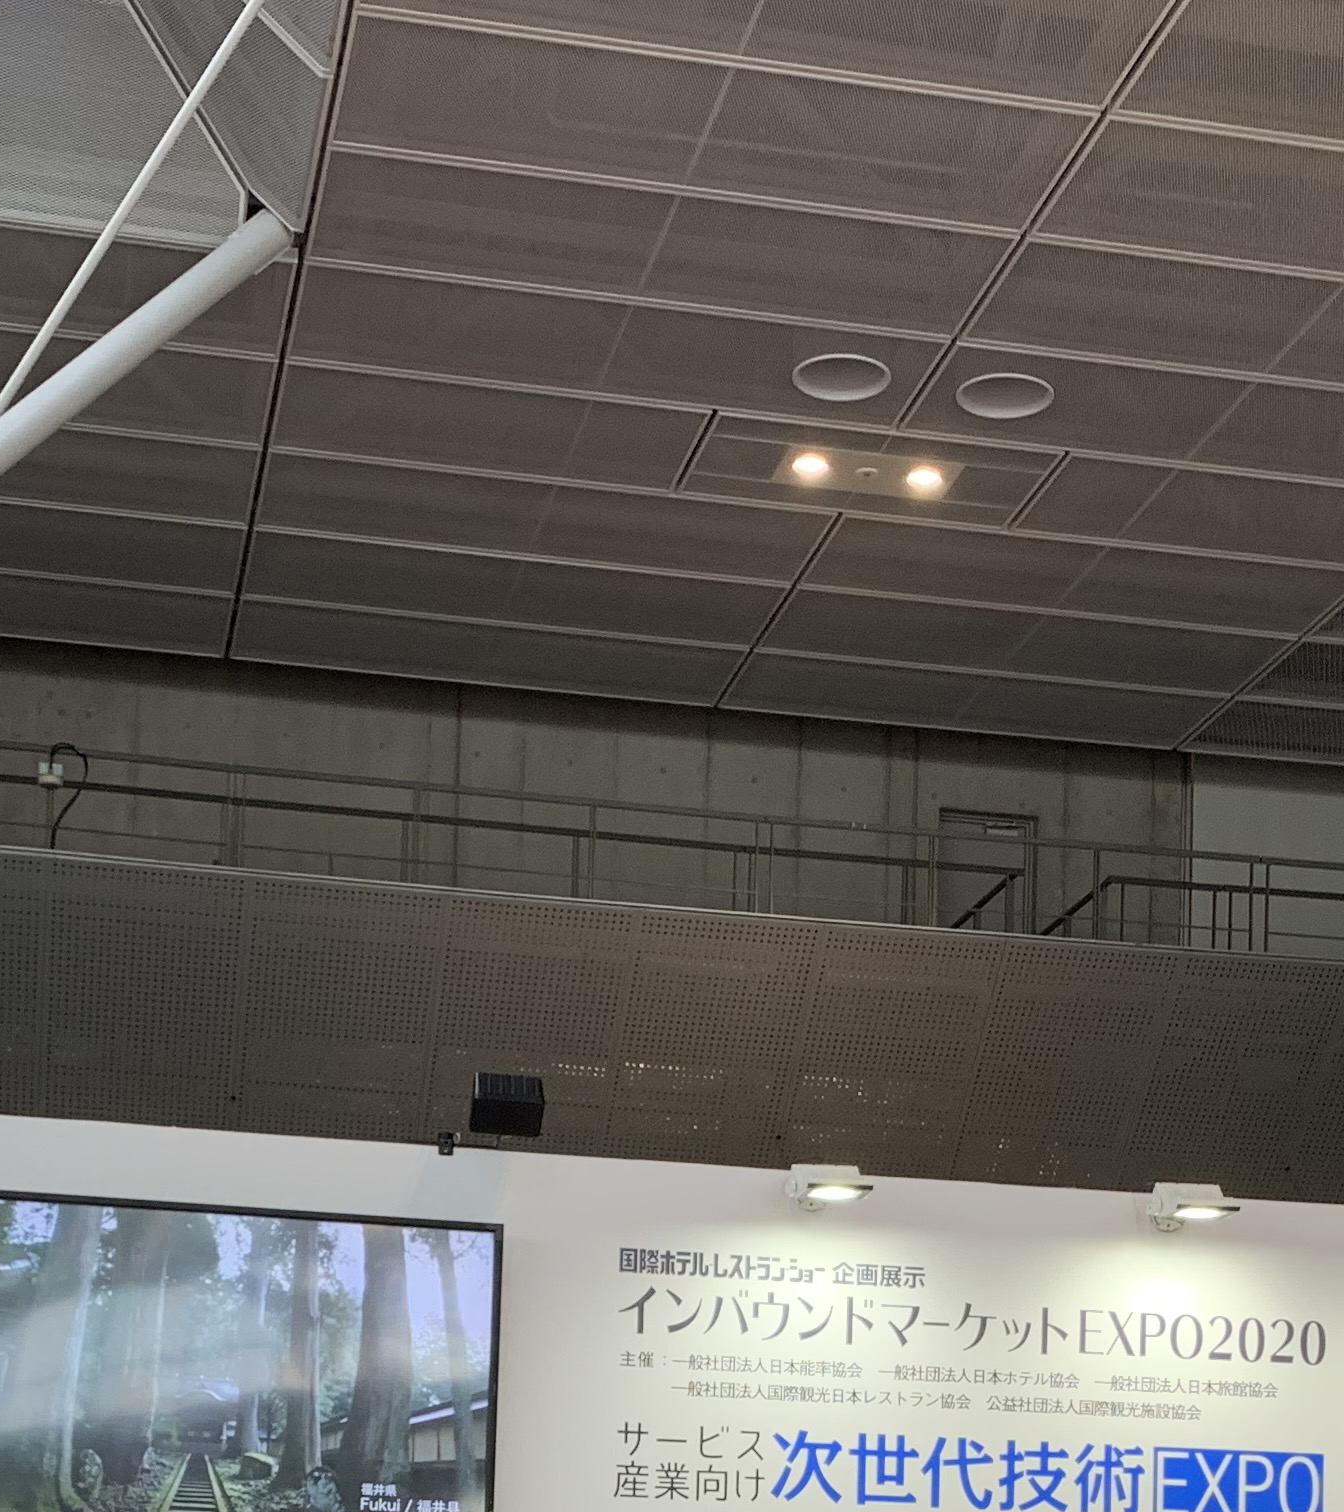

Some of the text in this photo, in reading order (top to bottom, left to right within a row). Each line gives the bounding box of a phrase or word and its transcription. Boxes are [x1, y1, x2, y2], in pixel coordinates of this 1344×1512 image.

[832, 1261, 927, 1289] 企画展示
[878, 1363, 1080, 1390] 一般社団法人日本ホテル協会
[1094, 1374, 1279, 1400] 一般社団法人日本旅館協会
[672, 1380, 1202, 1421] 一般社団法人国際観光日本レストラン協会 公益社団法人国際観光施設協会
[617, 1421, 764, 1461] サービス
[360, 1482, 397, 1497] 福井県
[613, 1460, 765, 1502] 産業向け
[359, 1497, 400, 1512] Fukui
